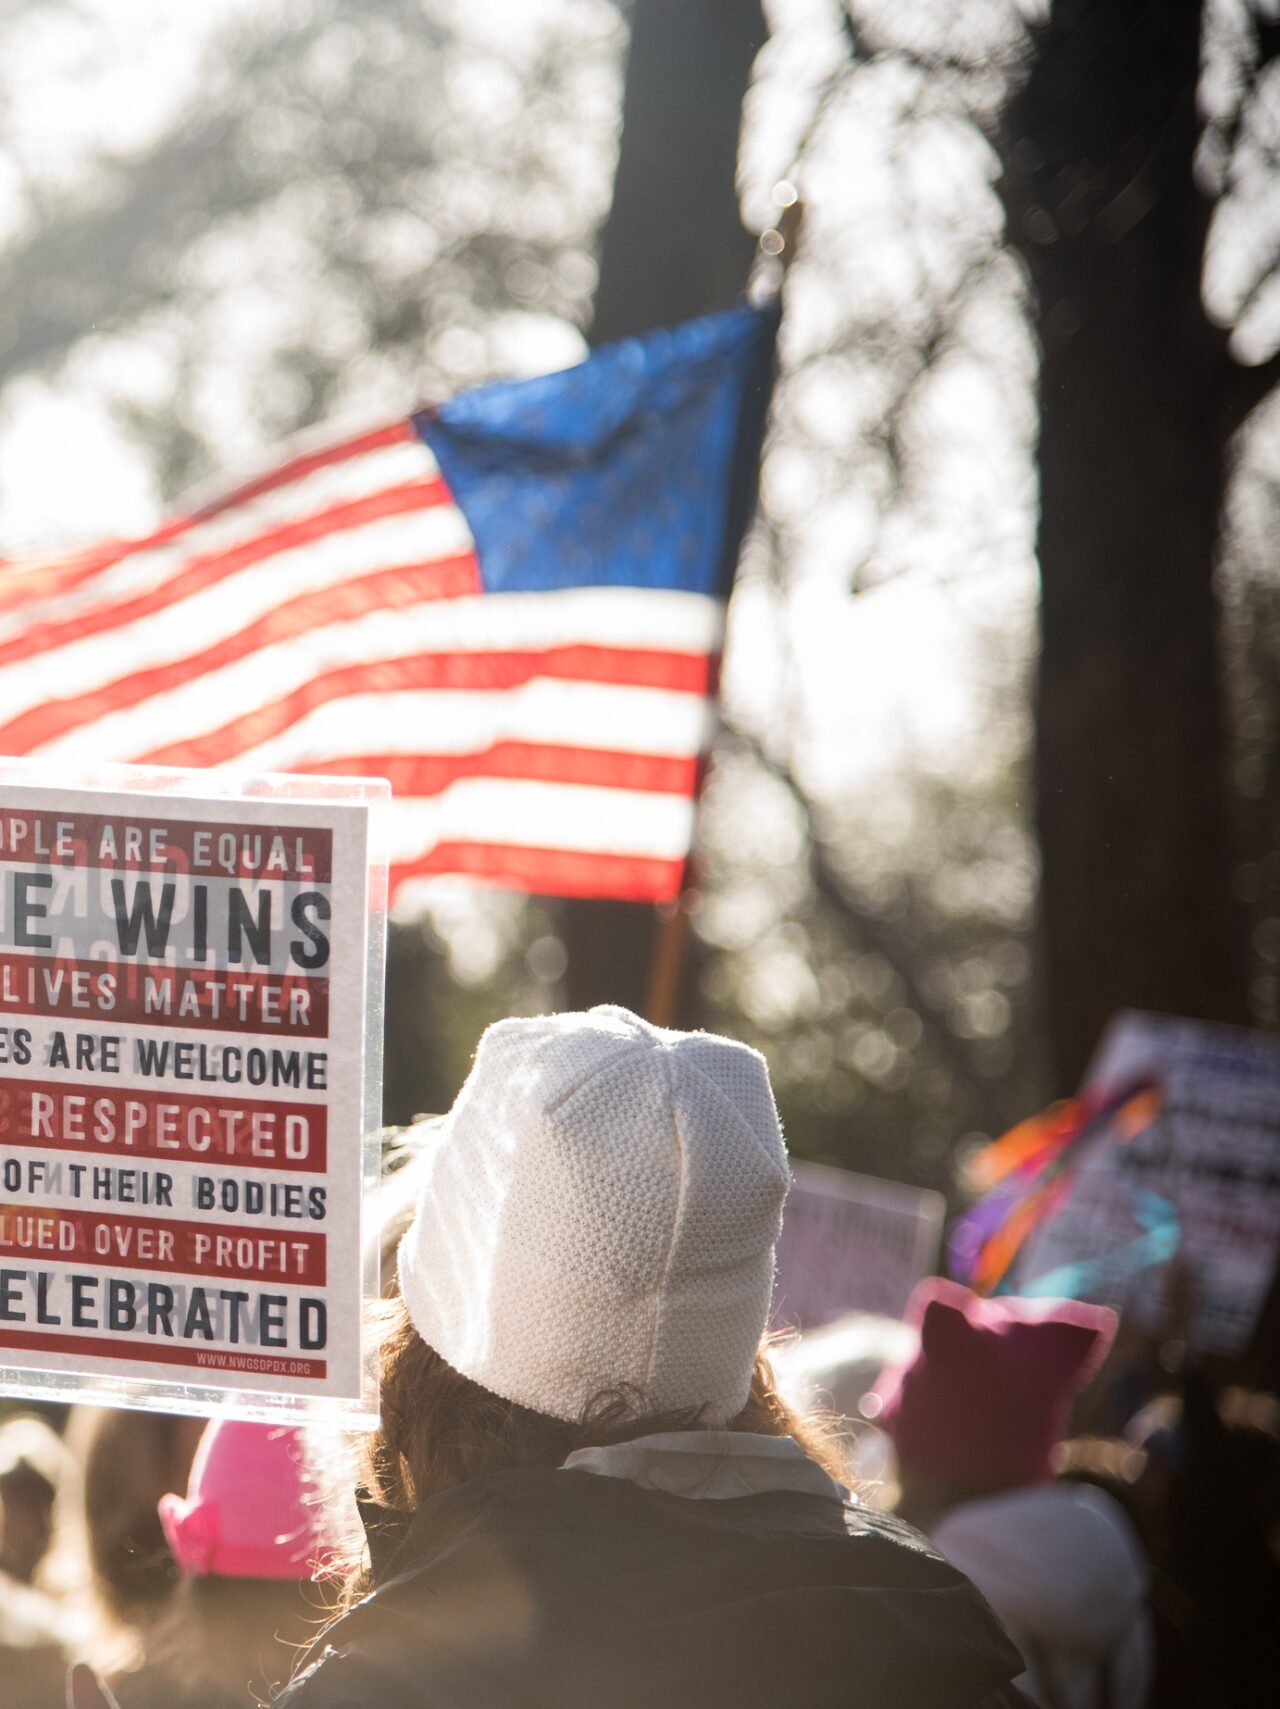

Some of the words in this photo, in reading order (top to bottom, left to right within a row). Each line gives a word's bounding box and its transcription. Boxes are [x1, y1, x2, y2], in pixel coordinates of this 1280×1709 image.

[99, 824, 168, 864] ARE
[193, 831, 313, 874] EQUAL
[111, 878, 332, 970] WINS
[2, 964, 117, 1010] LIVES
[144, 976, 311, 1026] MATTER
[49, 1031, 120, 1073] ARE
[137, 1038, 328, 1090] WELCOME
[31, 1091, 311, 1160] RESPECTED
[4, 1158, 46, 1194] OF
[69, 1164, 174, 1207] THEIR
[197, 1176, 328, 1221] BODIES
[94, 1223, 175, 1262] OVER
[195, 1233, 311, 1275] PROFIT
[196, 1352, 312, 1375] WWW.NWGSDPDX.ORG
